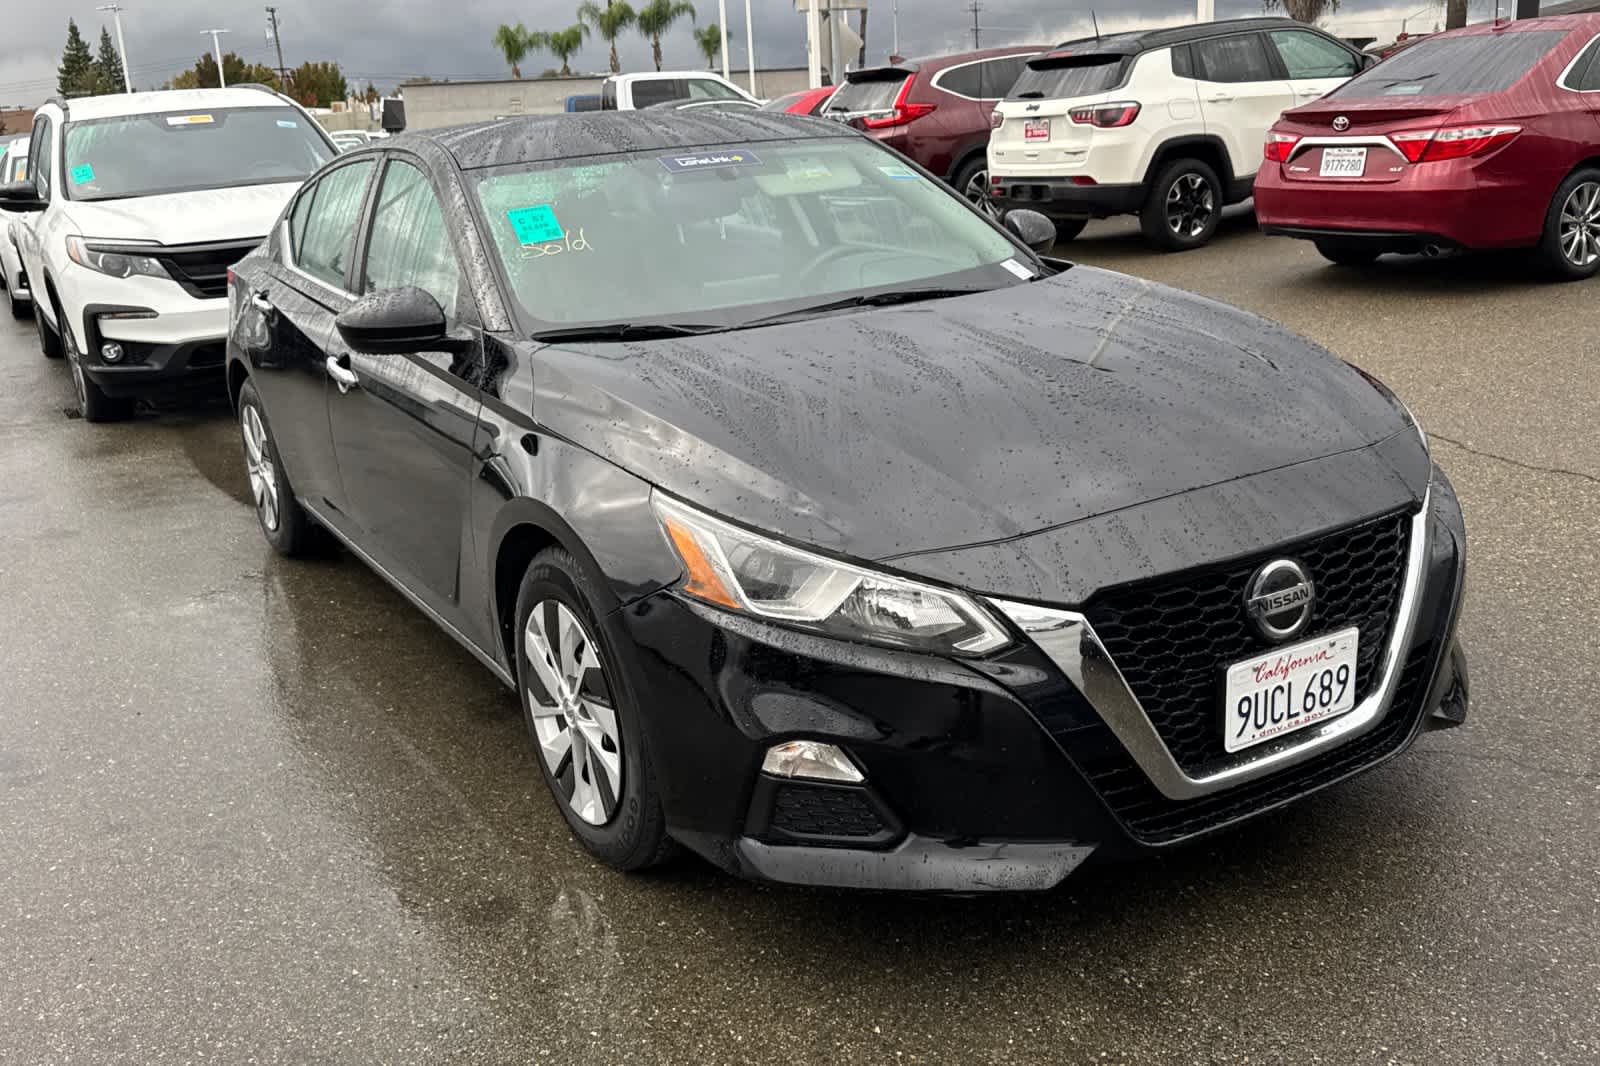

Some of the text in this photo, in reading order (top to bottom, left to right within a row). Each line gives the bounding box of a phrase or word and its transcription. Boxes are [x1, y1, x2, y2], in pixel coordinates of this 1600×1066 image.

[1257, 587, 1310, 612] NISSAN
[1254, 648, 1335, 685] California
[1236, 663, 1350, 739] 9UCL689
[1258, 709, 1325, 739] dmv.ca.gov
